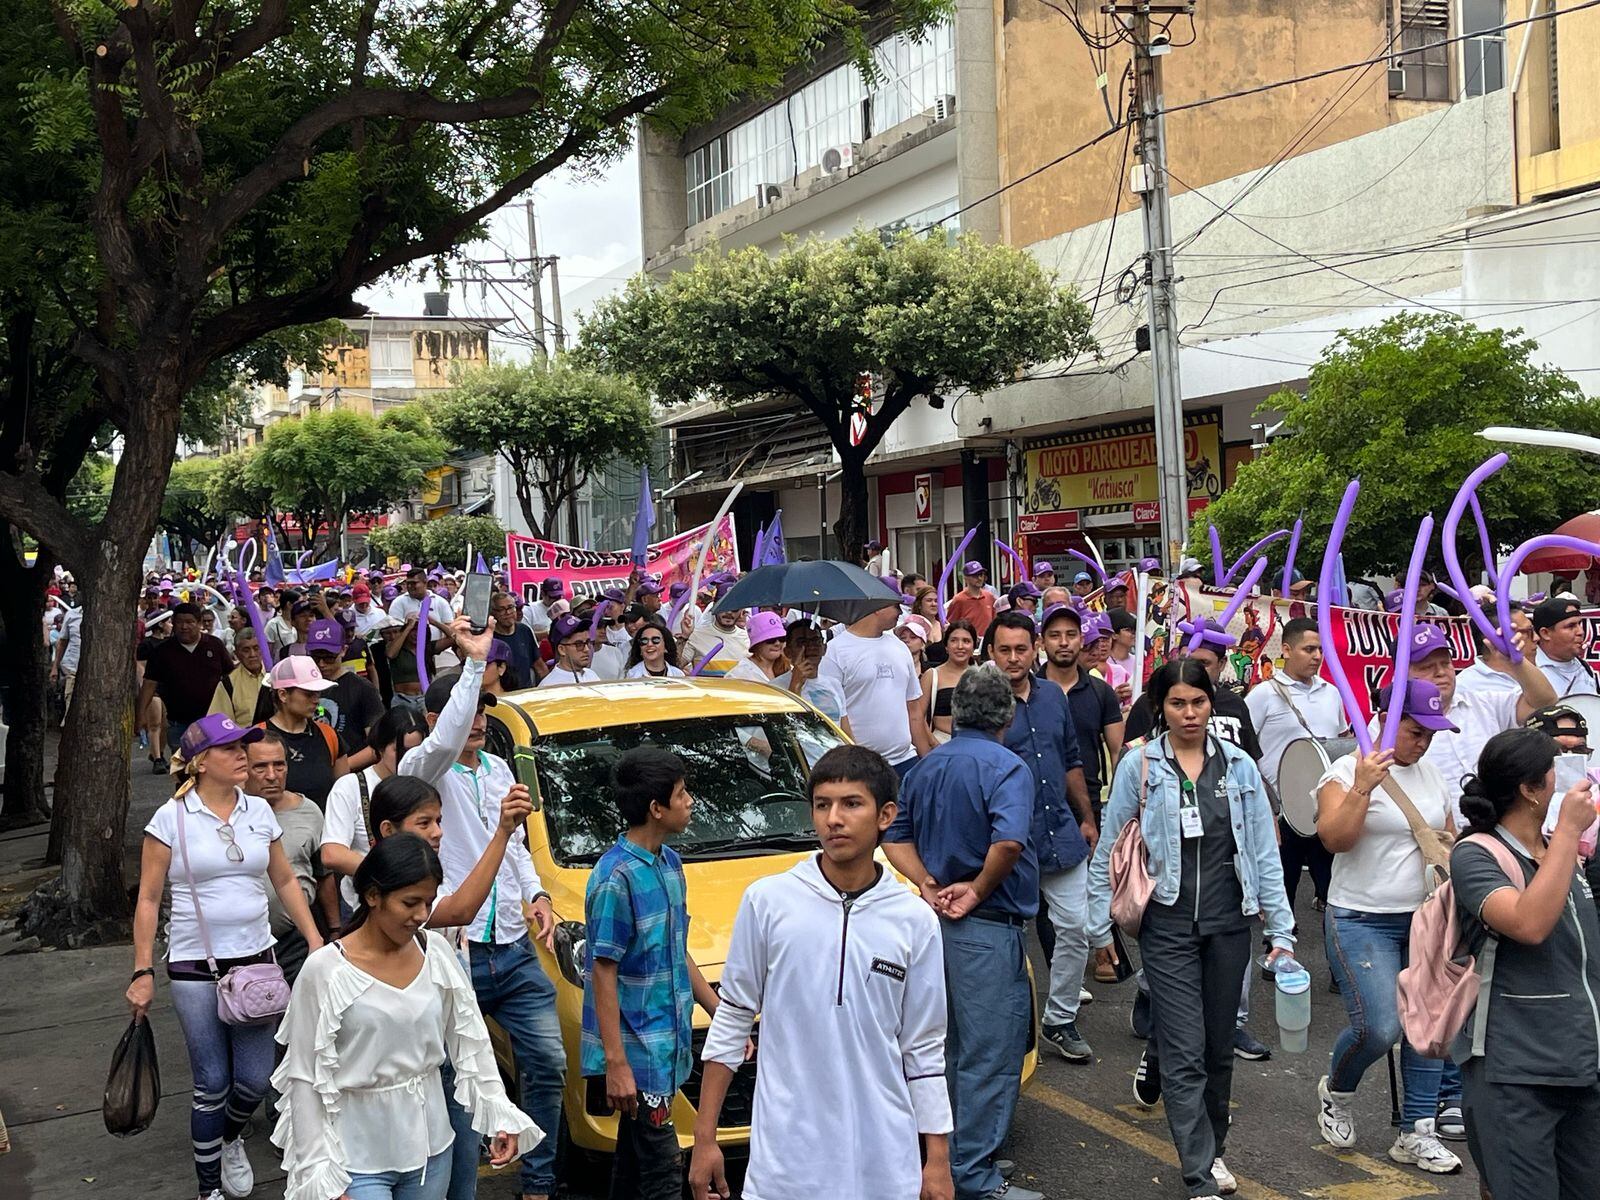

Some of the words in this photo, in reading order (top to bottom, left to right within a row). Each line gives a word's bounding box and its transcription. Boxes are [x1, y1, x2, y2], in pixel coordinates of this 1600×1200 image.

[1043, 449, 1079, 476] MOTO
[1136, 508, 1156, 520] Claro
[1020, 520, 1037, 531] Claro
